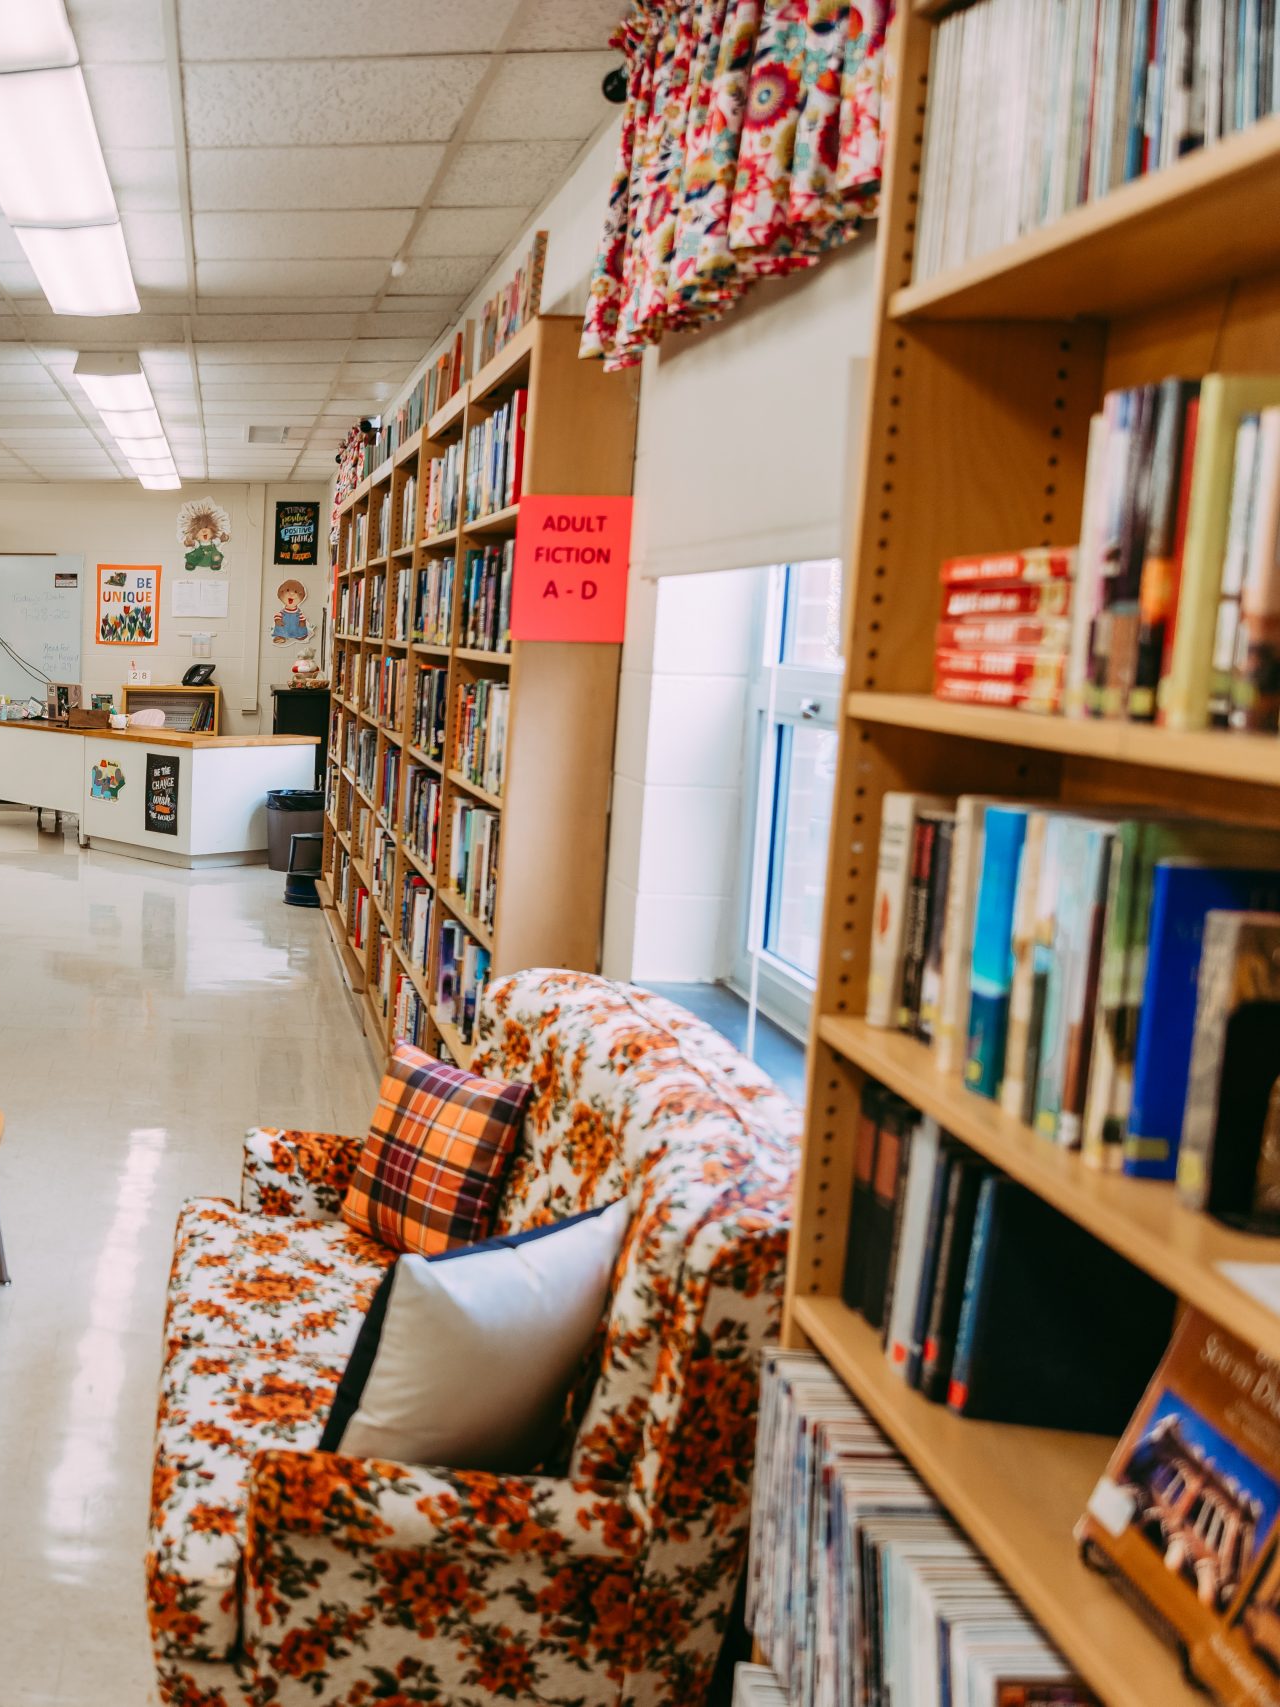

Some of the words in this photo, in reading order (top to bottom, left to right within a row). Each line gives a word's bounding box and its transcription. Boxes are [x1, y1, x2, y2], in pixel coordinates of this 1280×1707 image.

[542, 515, 608, 533] ADULT
[534, 546, 611, 565] FICTION
[136, 577, 153, 589] BE
[542, 580, 559, 599] A
[581, 580, 598, 600] D
[103, 591, 153, 604] UNIQUE
[153, 768, 161, 776] BE
[152, 777, 175, 790] CHANGE
